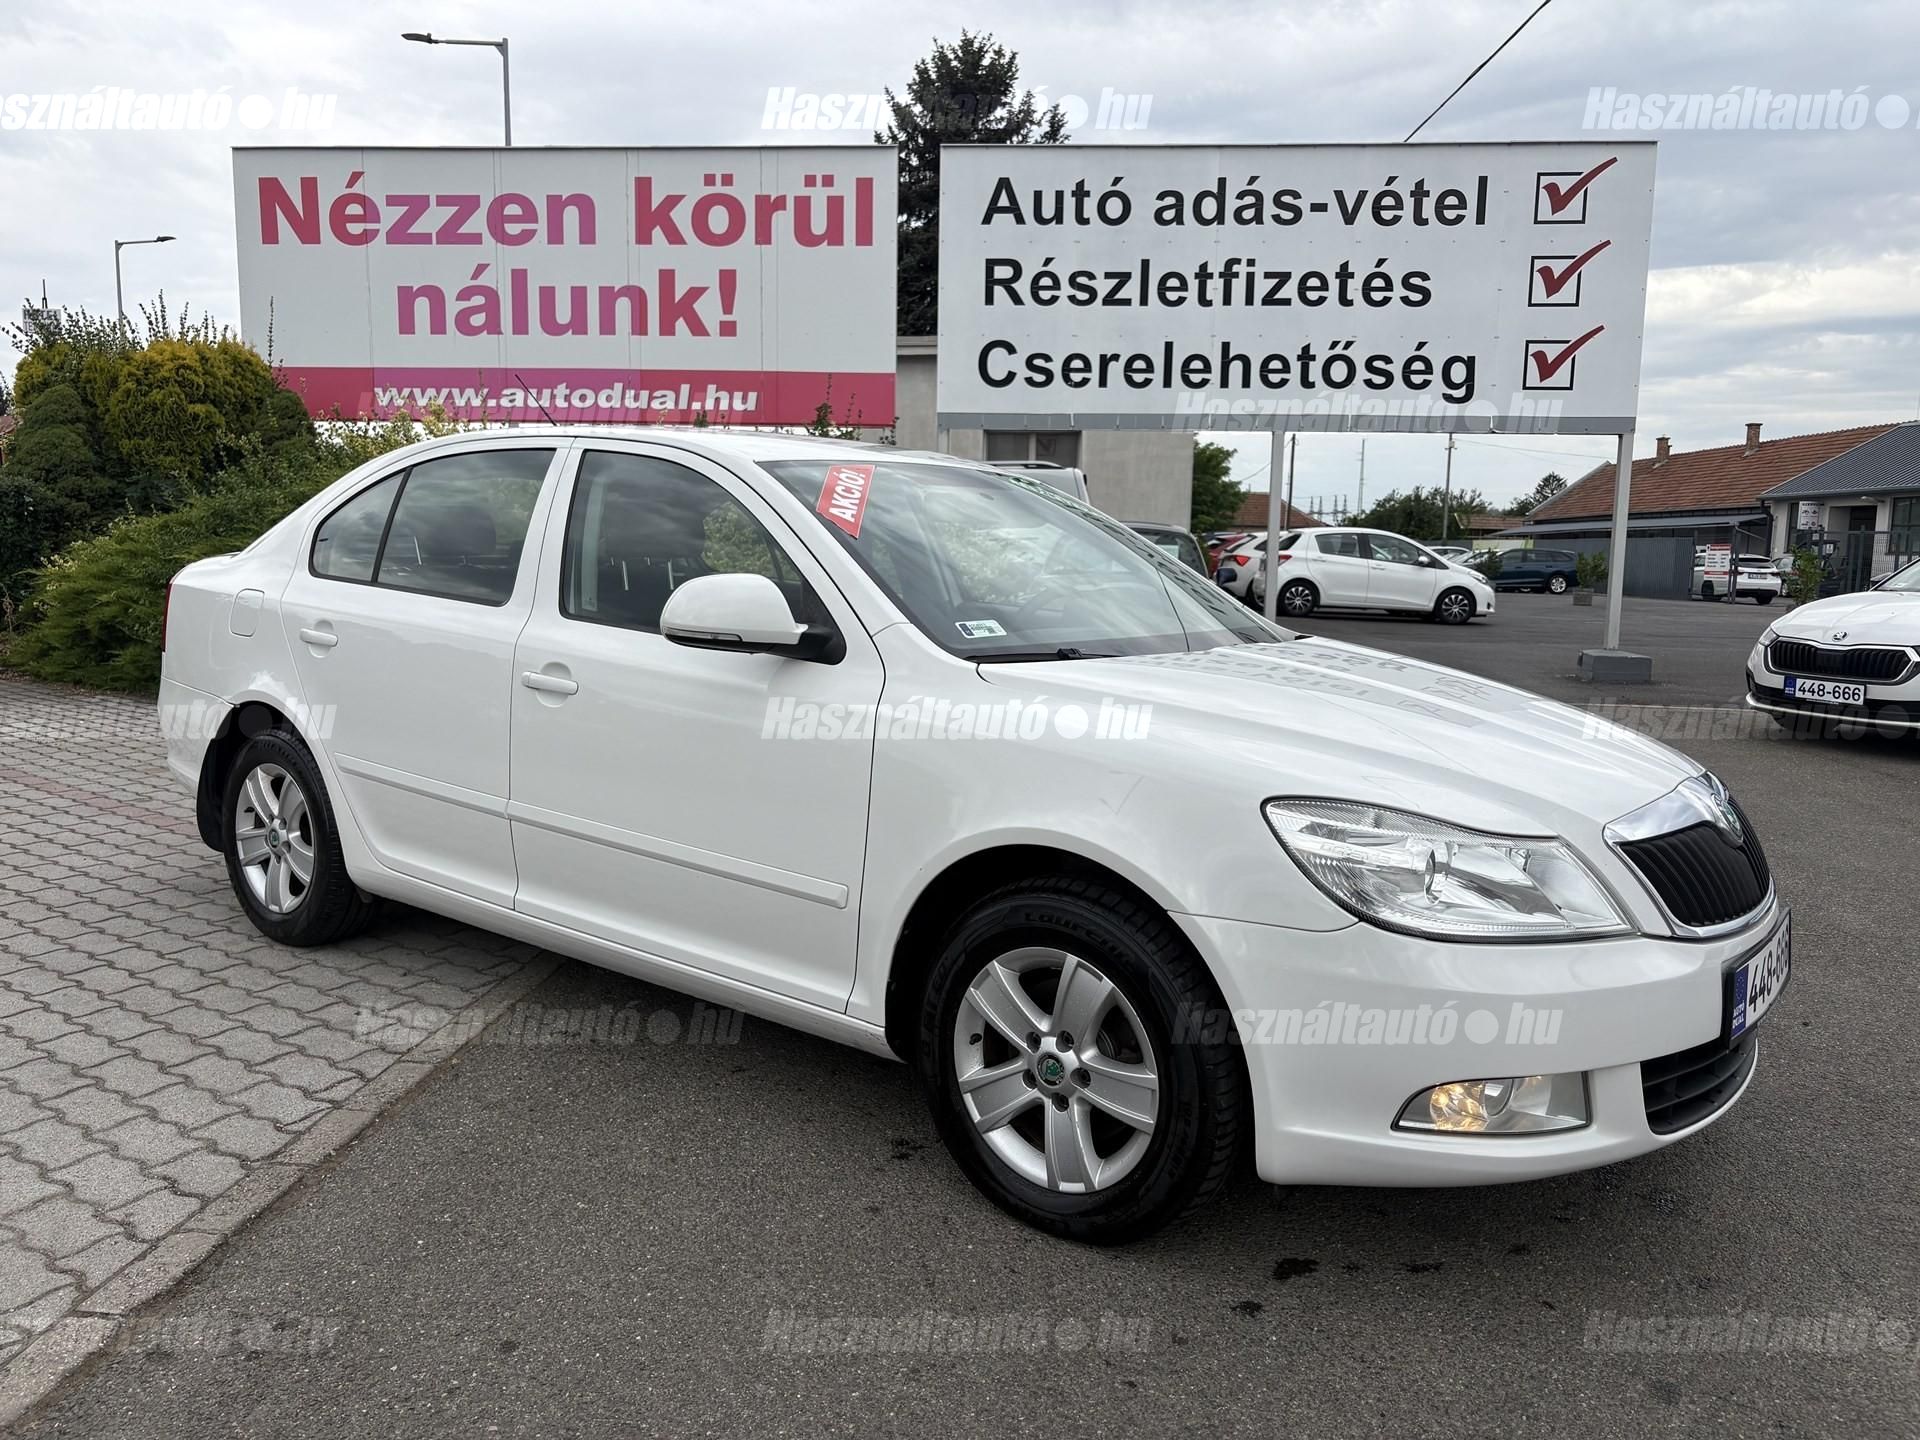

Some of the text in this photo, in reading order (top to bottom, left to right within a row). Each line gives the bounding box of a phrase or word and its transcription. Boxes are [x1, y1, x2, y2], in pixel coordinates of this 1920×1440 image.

[258, 171, 874, 248] Nézzen körül
[981, 175, 1489, 227] Autó adás-vétel
[397, 263, 737, 337] nálunk!
[984, 257, 1432, 308] Részletfizetés
[374, 382, 758, 412] www.autodual.hu
[978, 339, 1476, 405] Cserelehetőség
[828, 468, 866, 523] AKCIÓ!
[1798, 681, 1861, 702] 448-666
